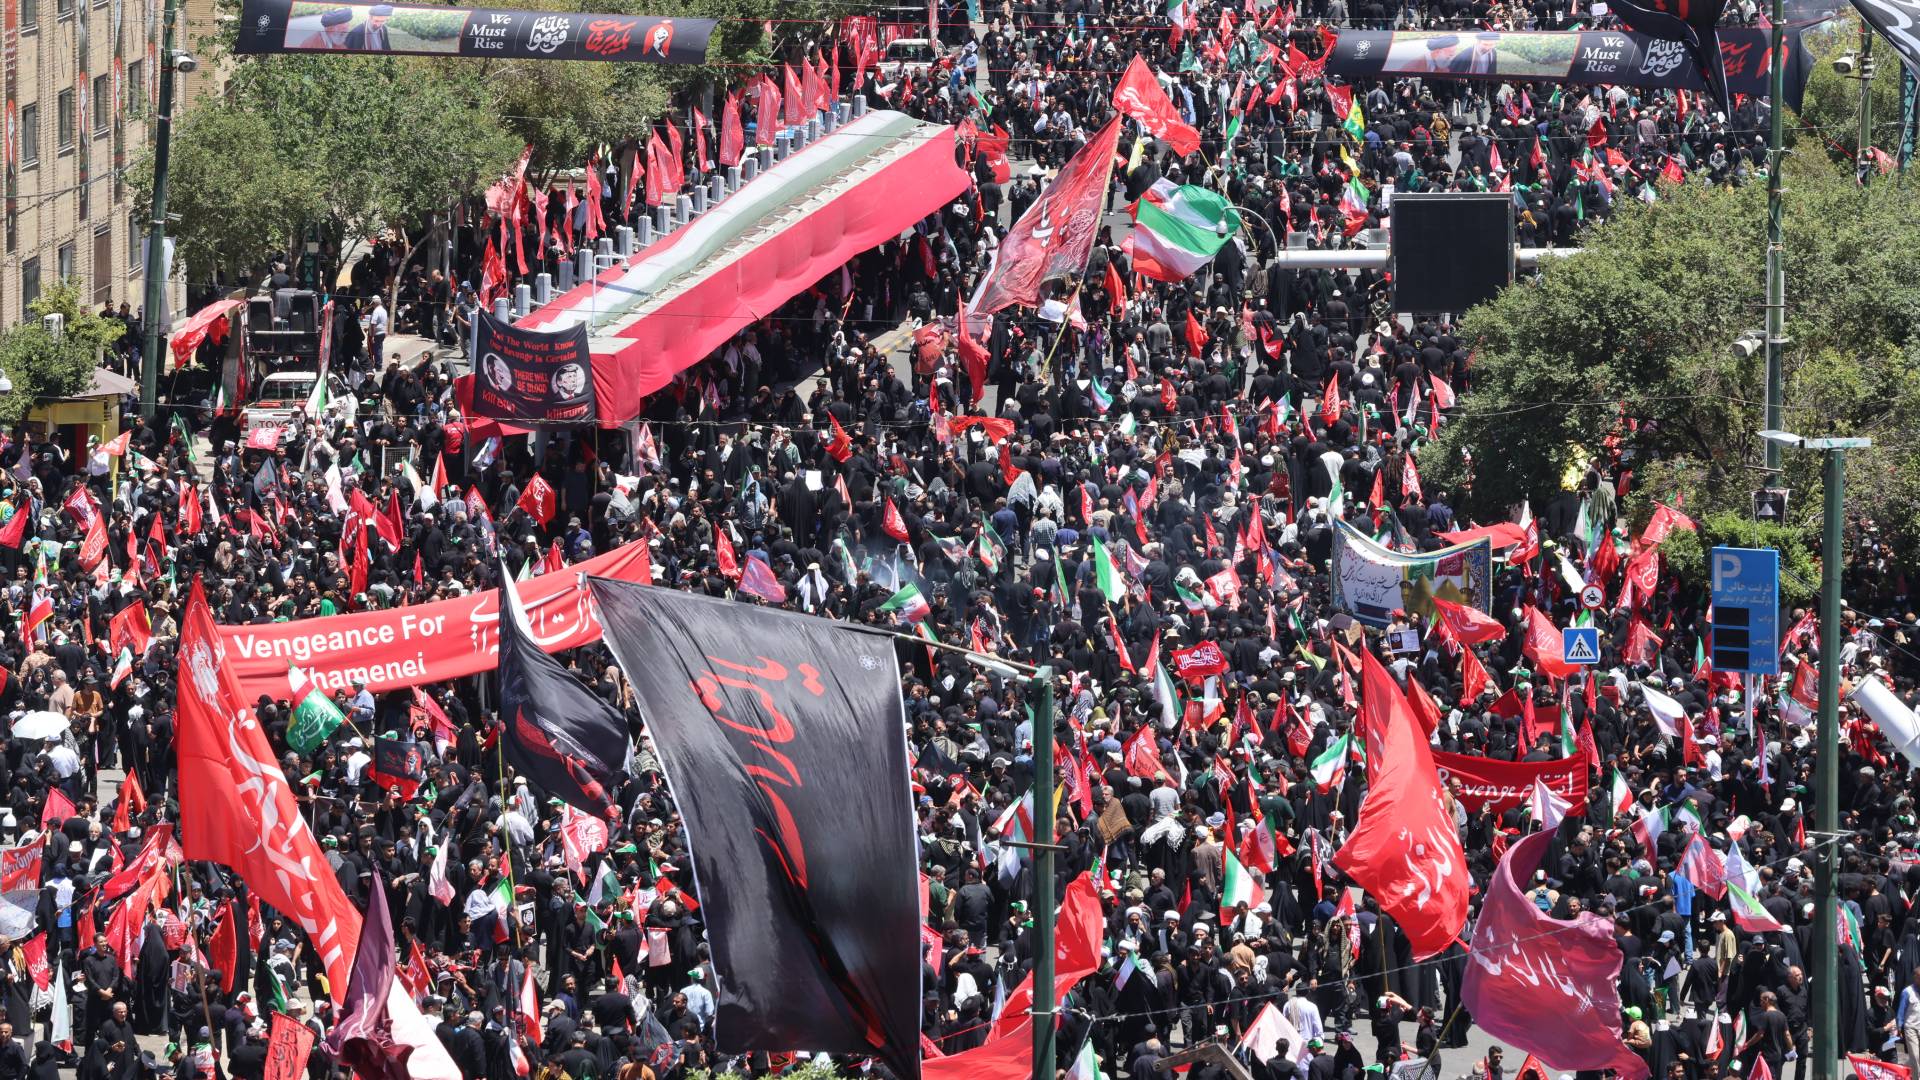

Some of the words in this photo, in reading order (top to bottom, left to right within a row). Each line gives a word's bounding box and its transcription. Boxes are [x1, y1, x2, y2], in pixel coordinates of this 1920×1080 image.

[490, 13, 512, 25] We
[469, 24, 506, 37] Must
[473, 37, 504, 49] Rise
[1601, 36, 1625, 48] We
[1582, 47, 1622, 60] Must
[1584, 60, 1616, 73] Rise
[507, 336, 520, 347] The
[523, 340, 549, 351] World
[513, 368, 534, 382] THERE
[534, 371, 549, 383] WILL
[517, 380, 526, 392] BE
[527, 382, 548, 394] BLOOD
[1714, 553, 1742, 592] P
[233, 621, 395, 662] Vengeance
[402, 612, 445, 641] For
[300, 652, 427, 690] hamenei
